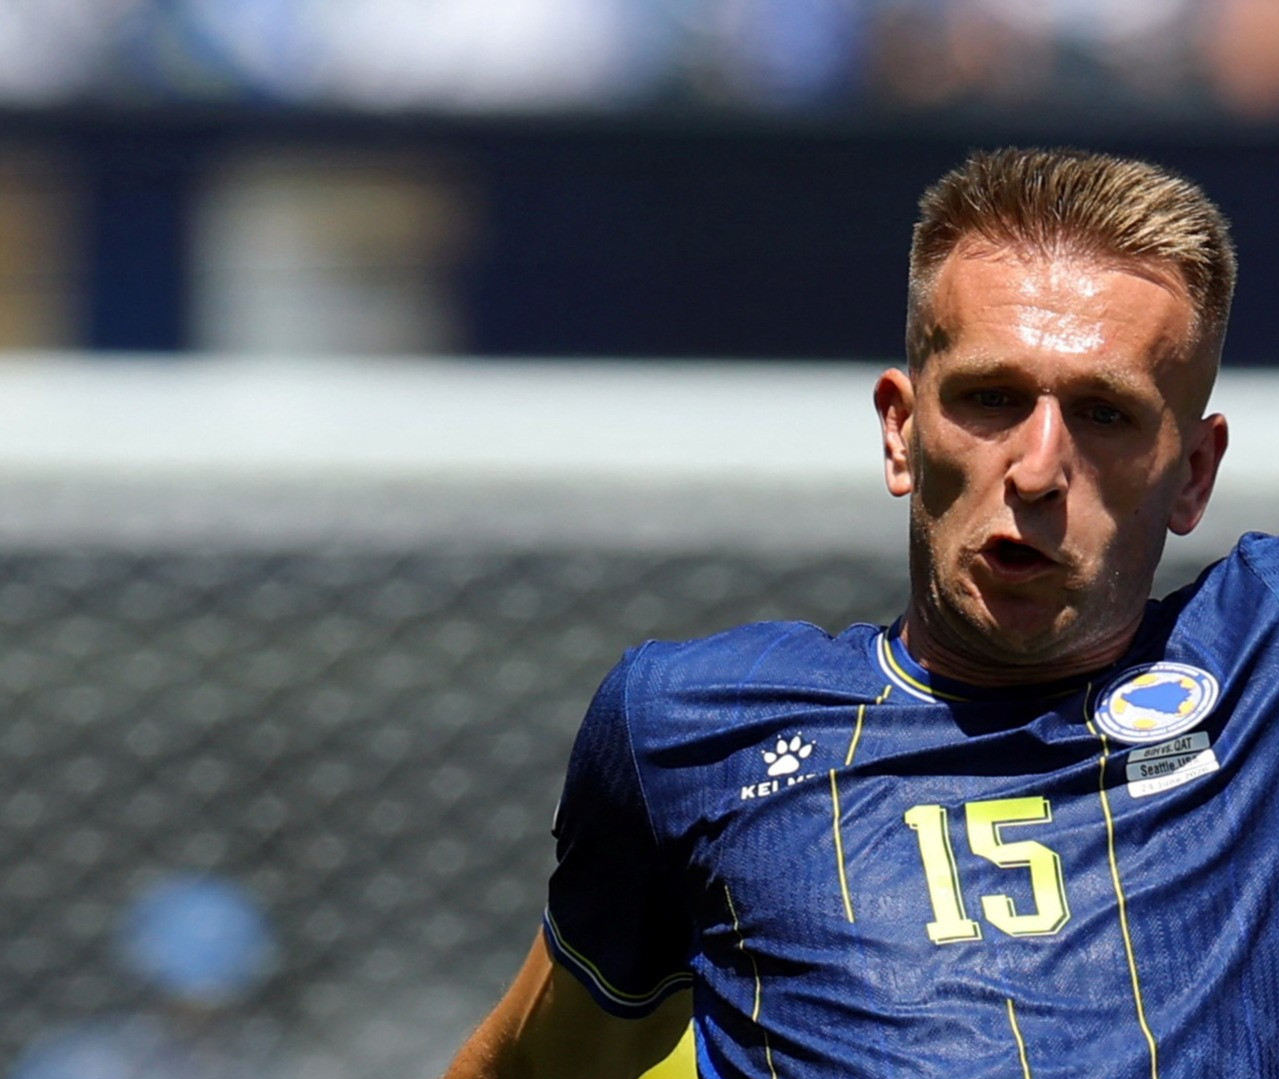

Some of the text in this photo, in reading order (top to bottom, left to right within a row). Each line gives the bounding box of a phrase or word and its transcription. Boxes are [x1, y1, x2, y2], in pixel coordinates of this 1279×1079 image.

[1174, 738, 1192, 751] QAT
[741, 773, 816, 800] KEL
[905, 796, 1071, 945] 15
